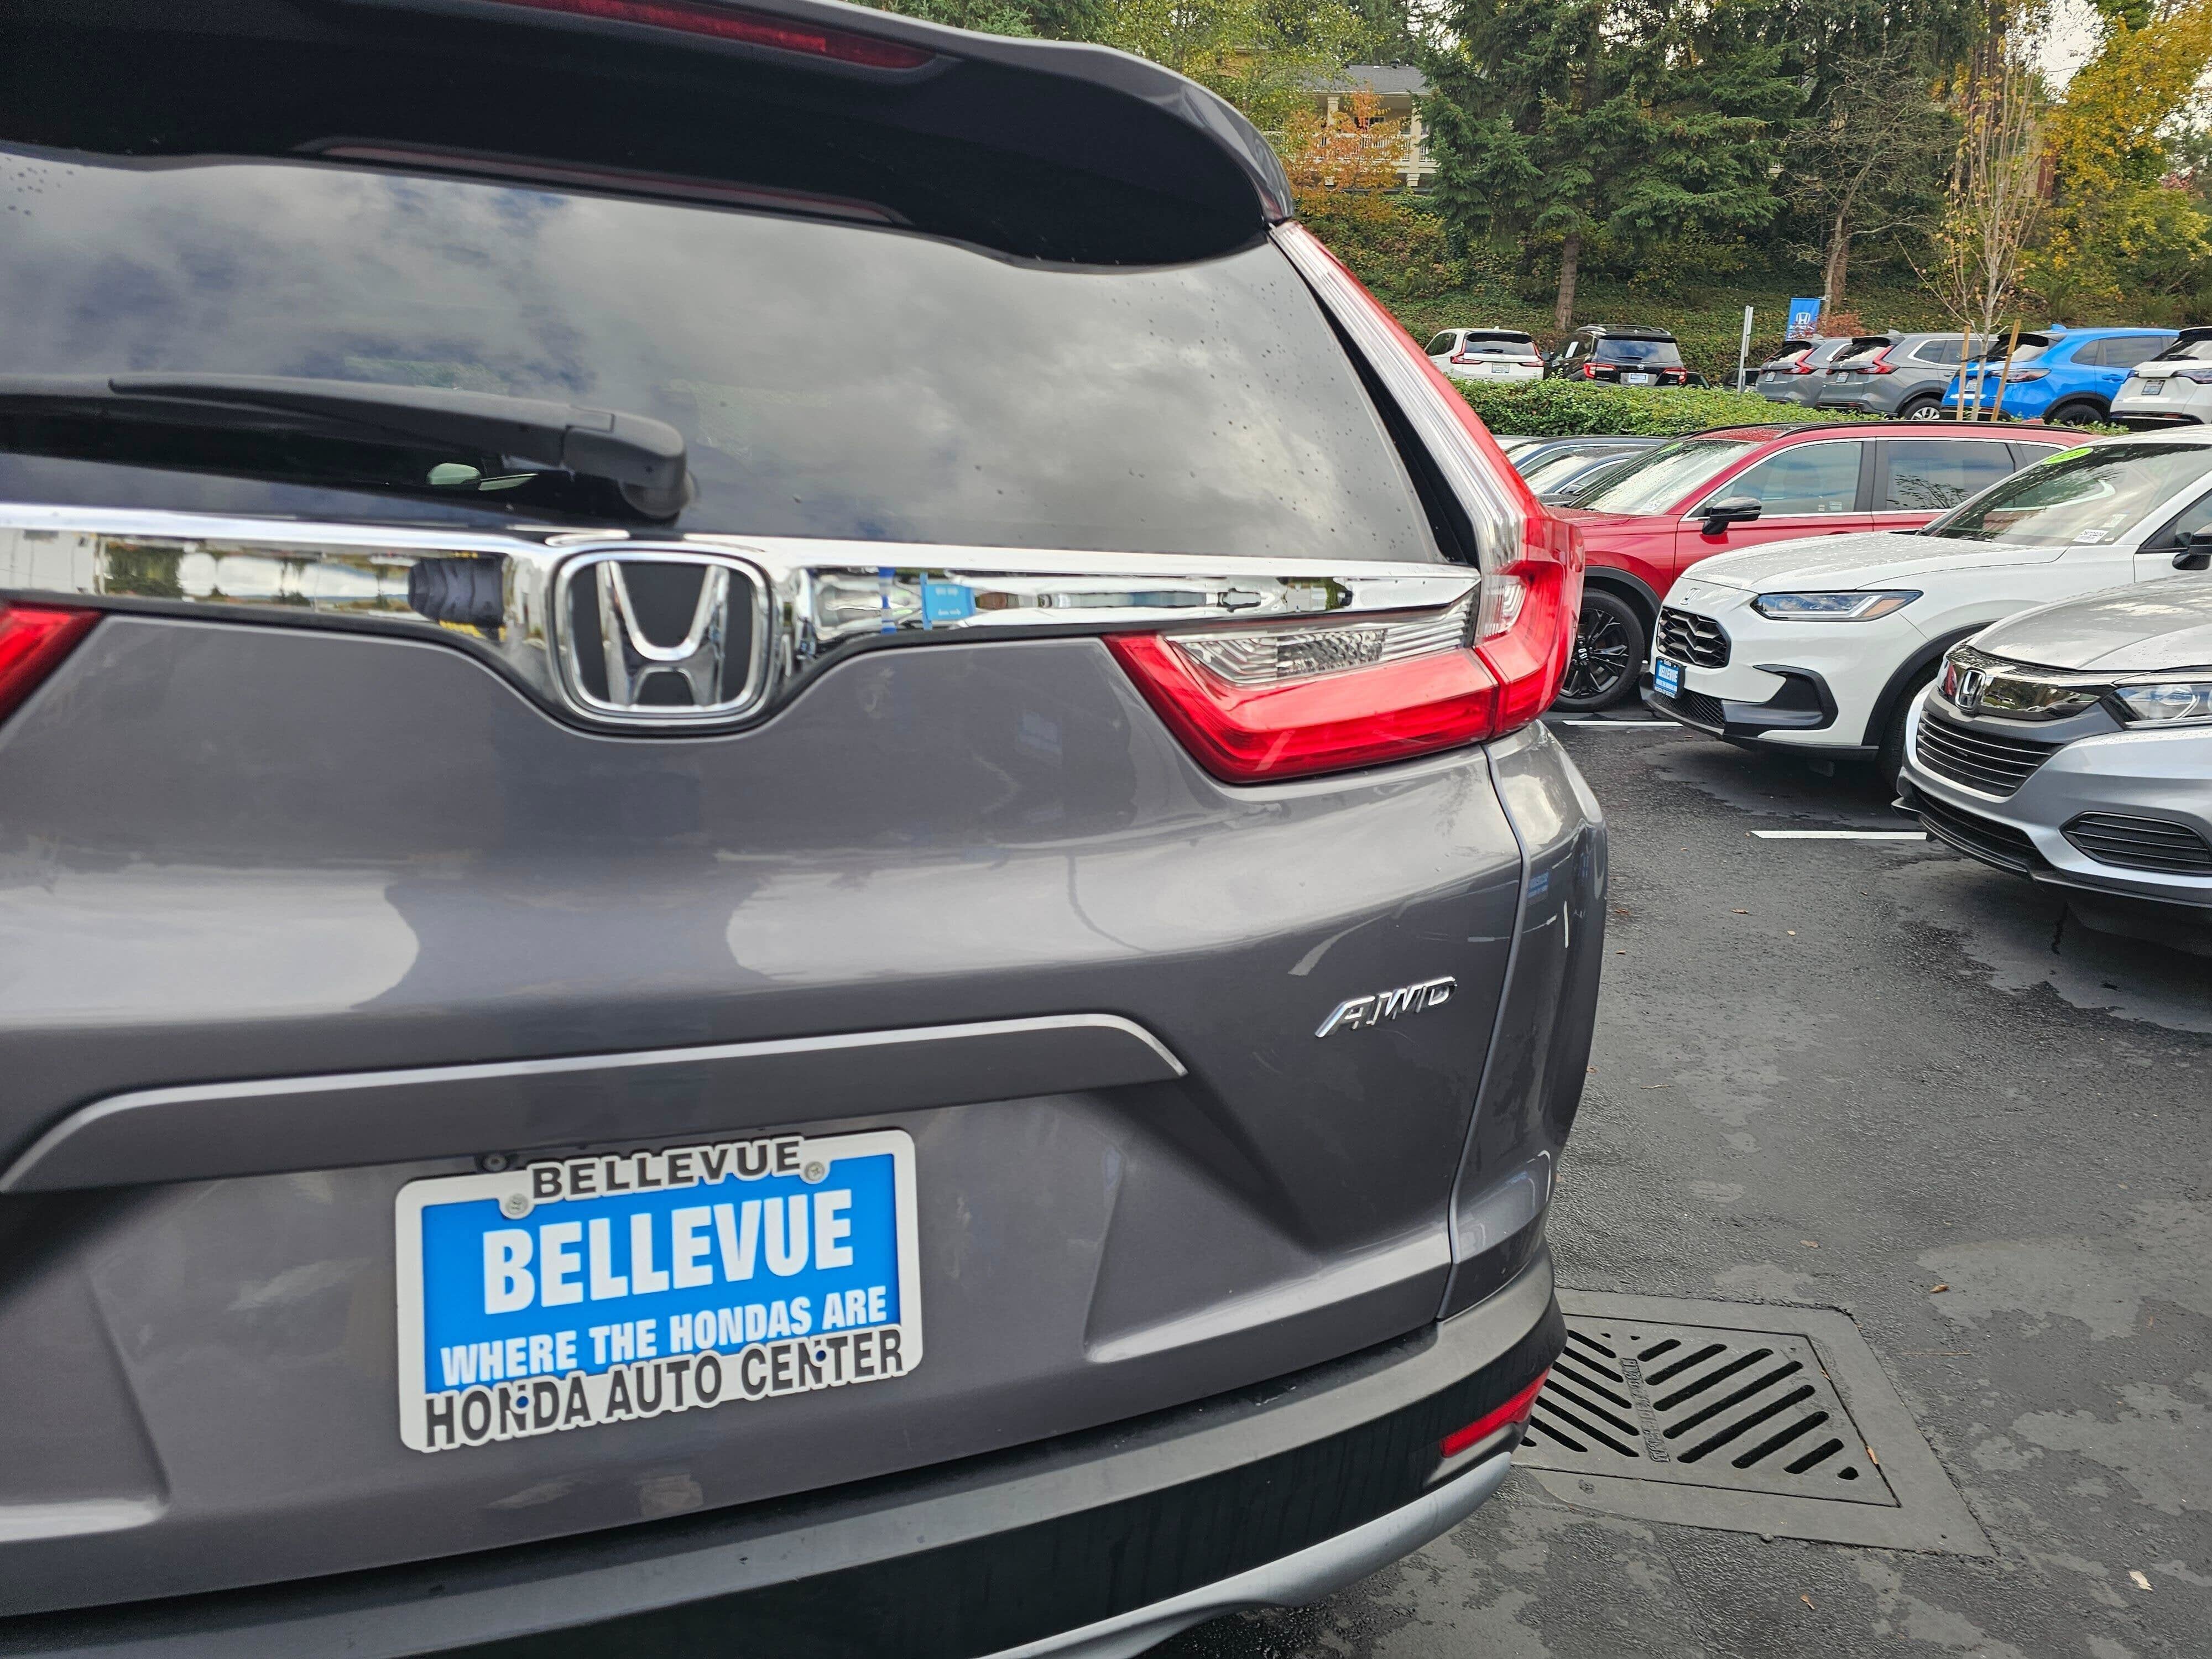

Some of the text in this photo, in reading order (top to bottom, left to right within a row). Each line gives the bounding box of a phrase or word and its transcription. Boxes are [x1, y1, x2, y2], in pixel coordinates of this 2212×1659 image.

[1314, 976, 1457, 1037] AWD
[533, 1141, 800, 1199] BELLEVUE
[482, 1189, 853, 1314] BELLEVUE
[441, 1285, 887, 1386] WHERE THE HONDAS ARE
[425, 1329, 902, 1447] HONDA AUTO CENTER
